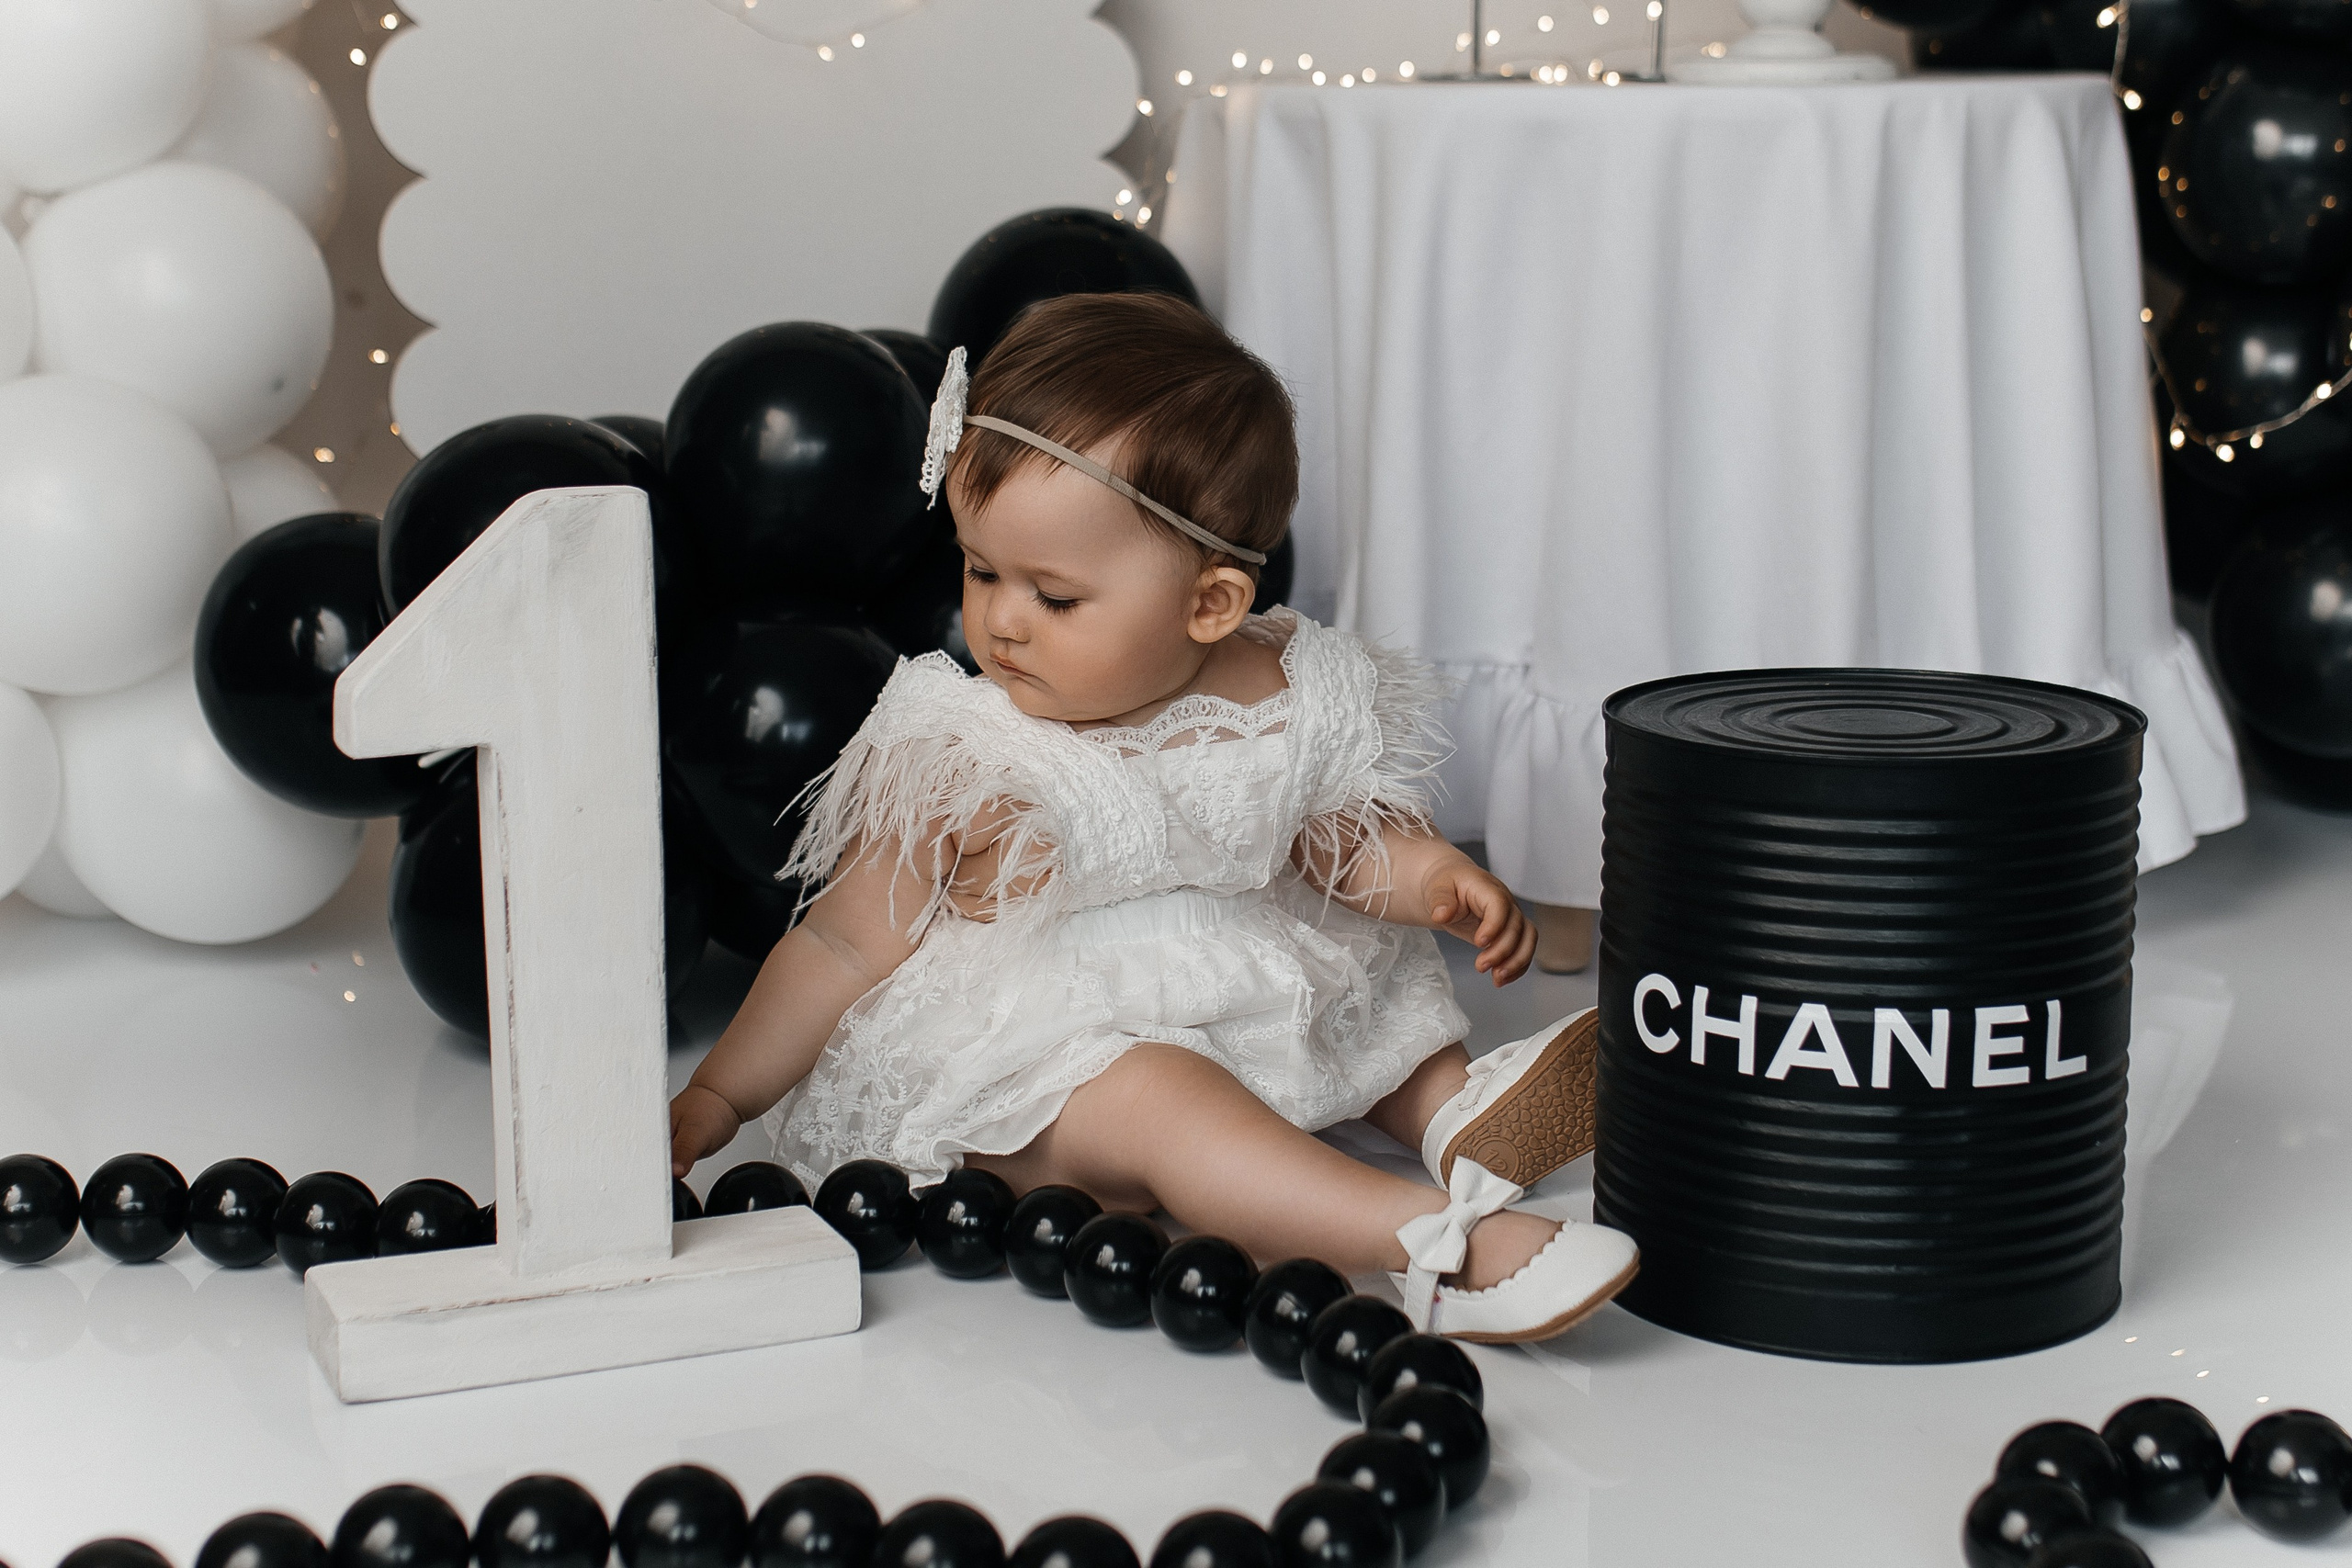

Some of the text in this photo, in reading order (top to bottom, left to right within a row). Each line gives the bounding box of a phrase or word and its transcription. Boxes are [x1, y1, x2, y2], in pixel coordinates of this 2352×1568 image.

[304, 485, 862, 1404] 1
[1633, 973, 2087, 1089] CHANEL
[1484, 1149, 1508, 1173] 12
